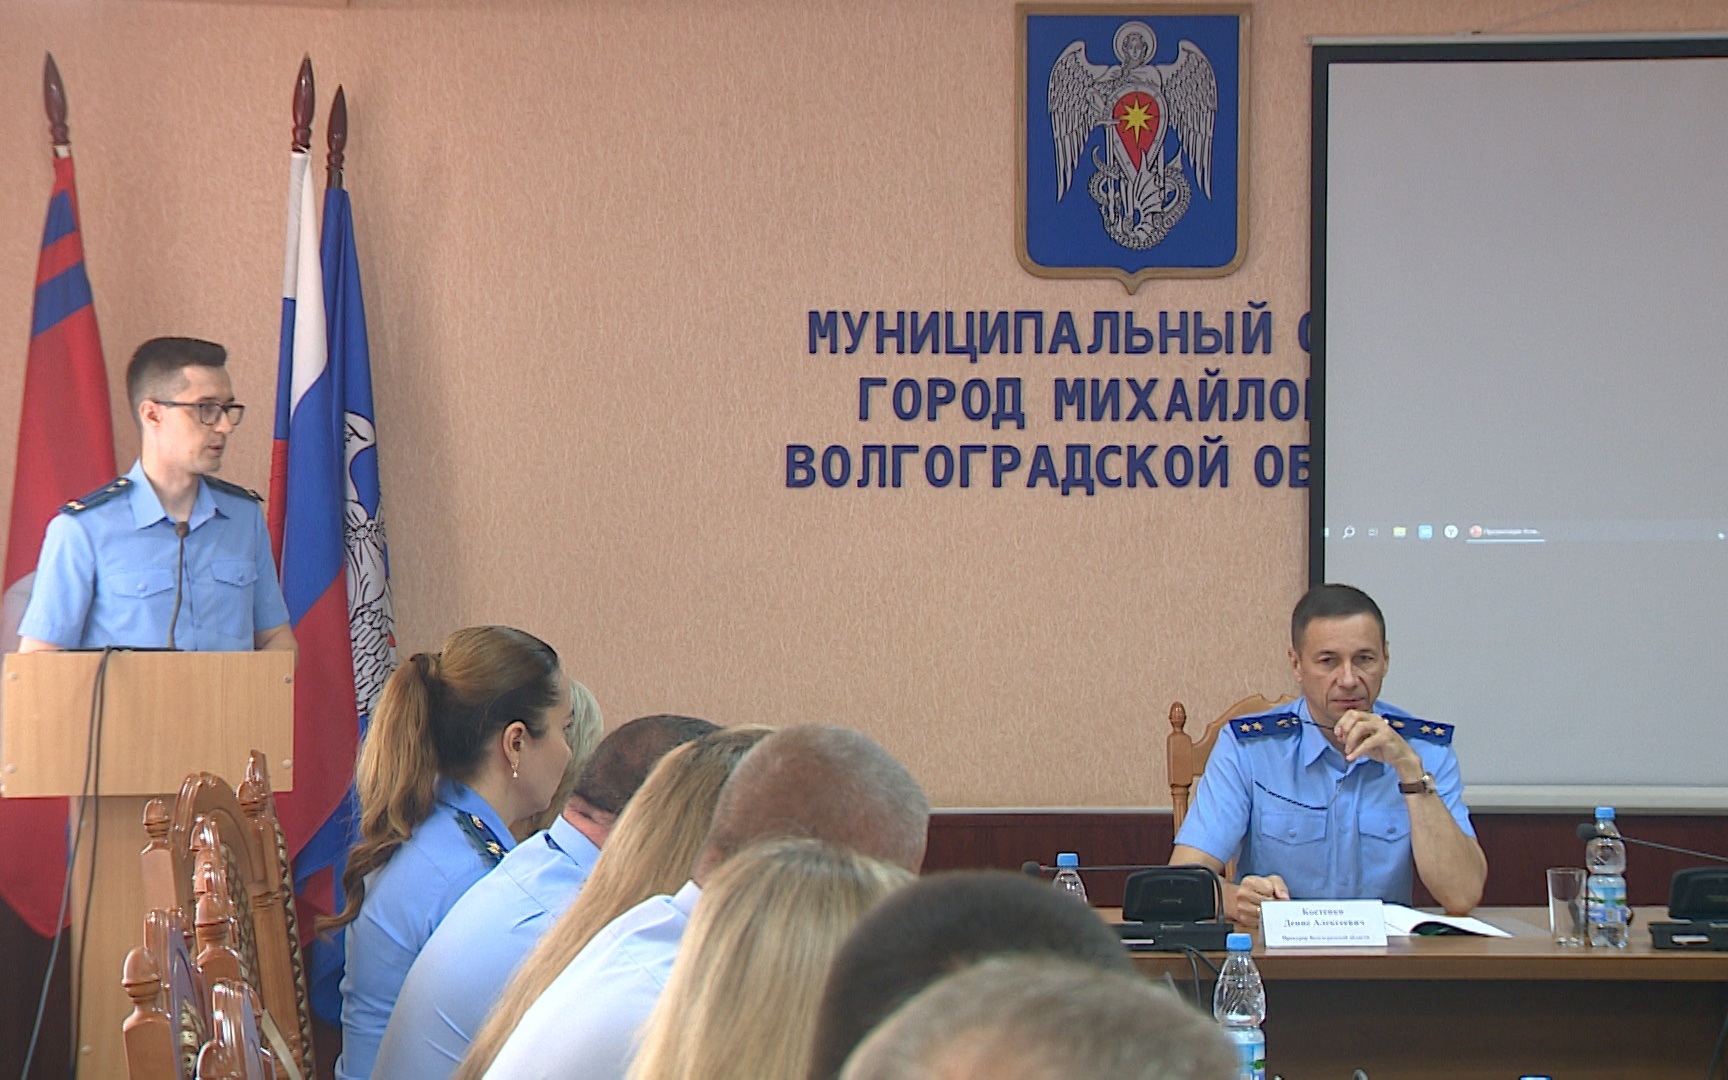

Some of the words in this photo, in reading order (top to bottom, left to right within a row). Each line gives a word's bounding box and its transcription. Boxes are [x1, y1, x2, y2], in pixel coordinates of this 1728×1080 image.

[808, 301, 1273, 363] МУНИЦИПАЛЬНЫЙ
[859, 377, 1026, 430] ГОРОД
[1054, 368, 1310, 422] МИХАЙЛО
[786, 436, 1229, 496] ВОЛГОГРАДСКОЙ
